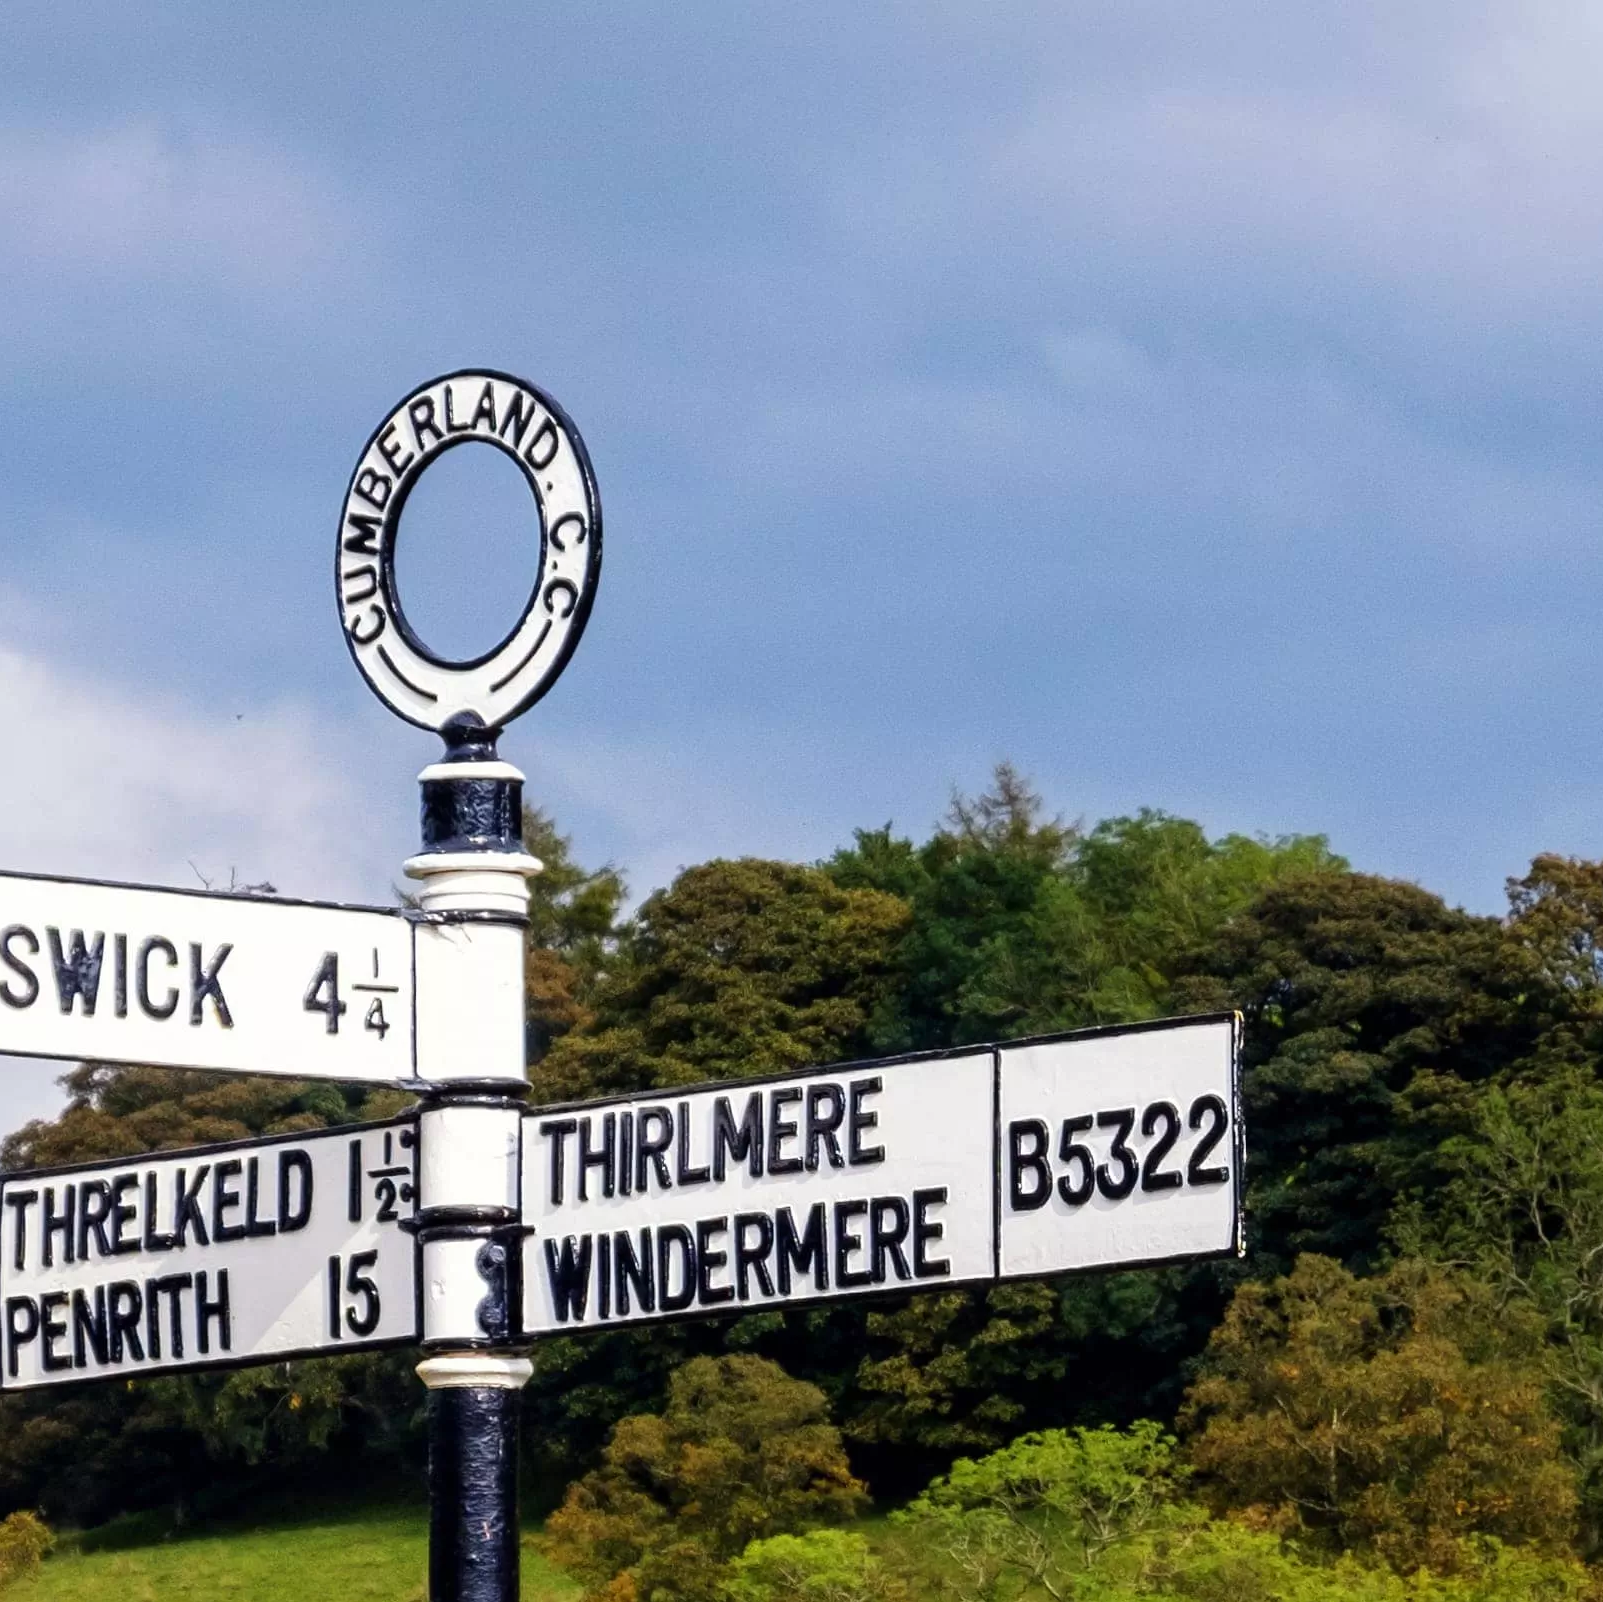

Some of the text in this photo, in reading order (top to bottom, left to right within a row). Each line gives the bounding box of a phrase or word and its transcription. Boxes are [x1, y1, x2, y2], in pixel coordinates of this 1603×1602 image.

[540, 1075, 885, 1205] THIRLMERE
[1009, 1095, 1229, 1211] B5322
[5, 1148, 313, 1270] THRELKELD
[544, 1187, 949, 1321] WINDERMERE
[6, 1249, 380, 1377] PENRITH 15
